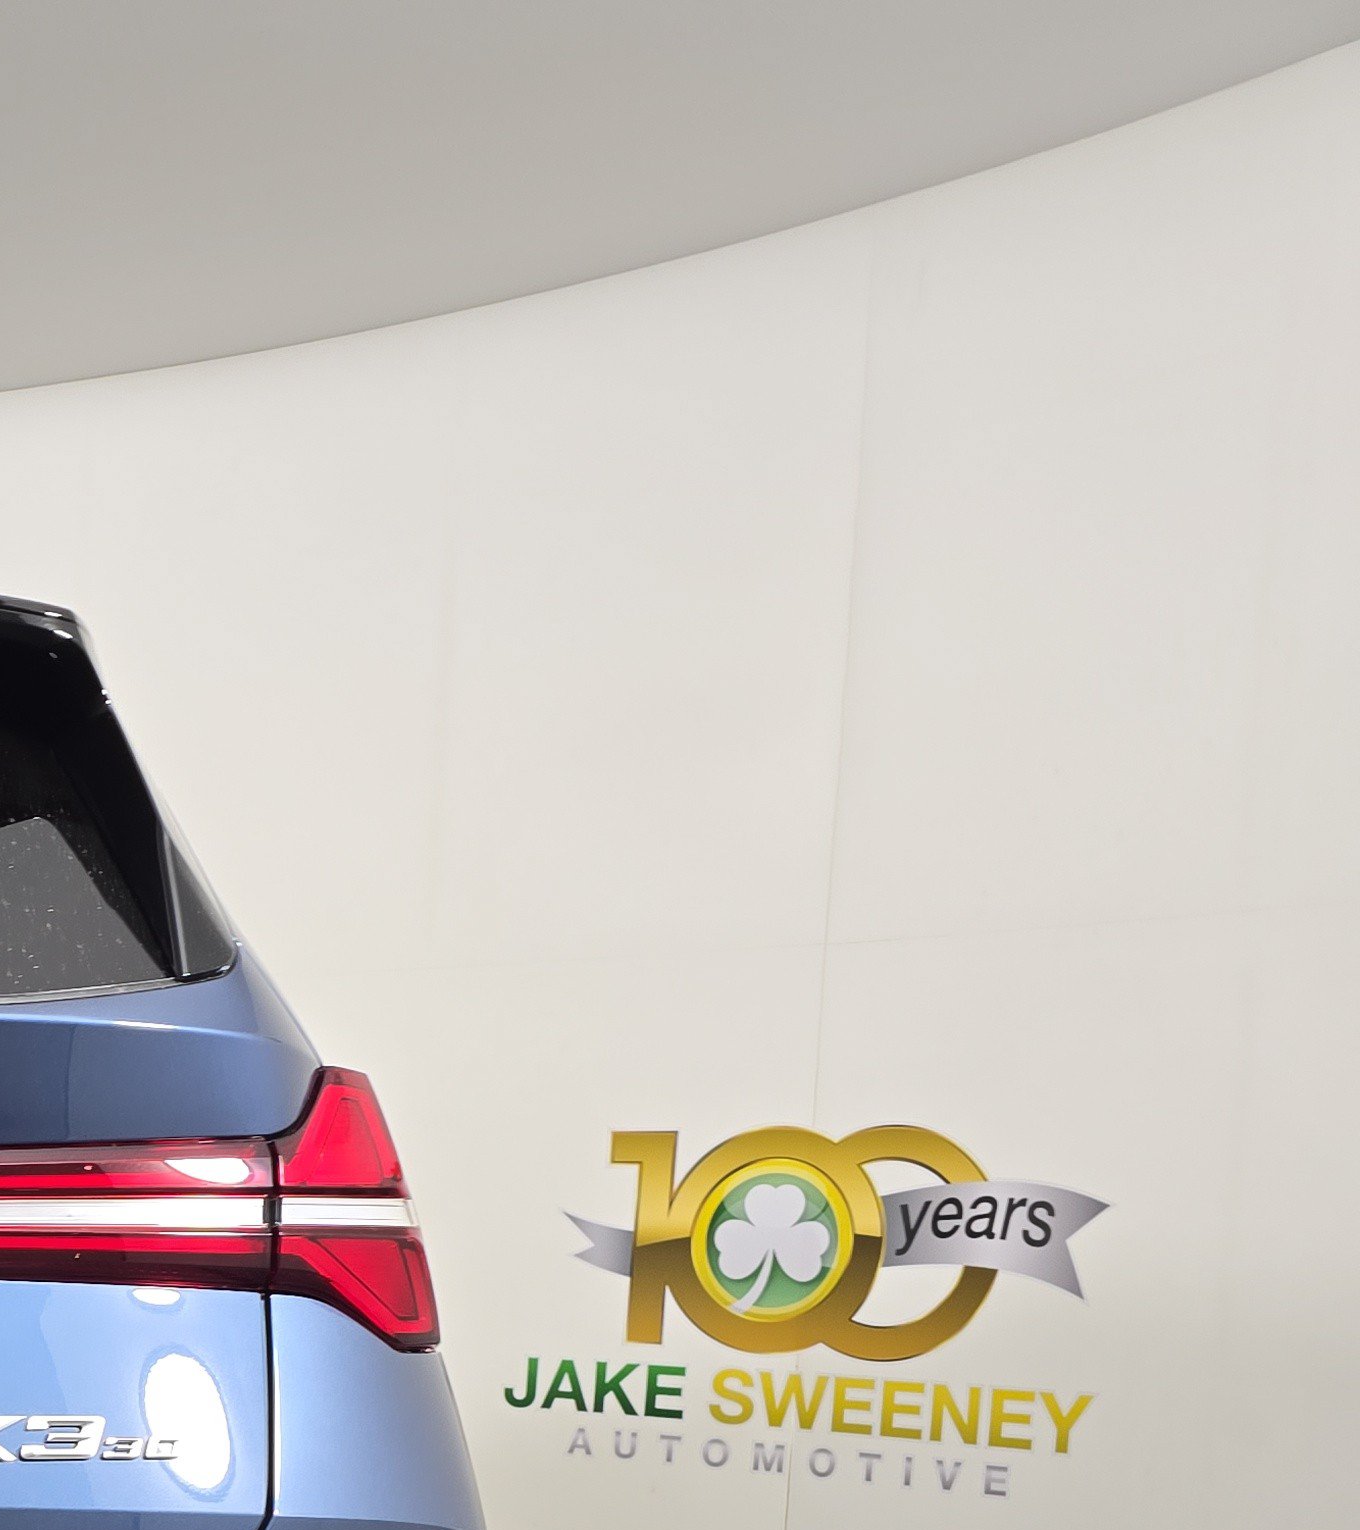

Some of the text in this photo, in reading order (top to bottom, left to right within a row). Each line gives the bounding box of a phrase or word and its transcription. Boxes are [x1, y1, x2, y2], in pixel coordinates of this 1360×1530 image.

[610, 1125, 1056, 1362] 100 years
[504, 1357, 1094, 1454] JAKE SWEENEY
[568, 1427, 1009, 1497] AUTOMOTIVE
